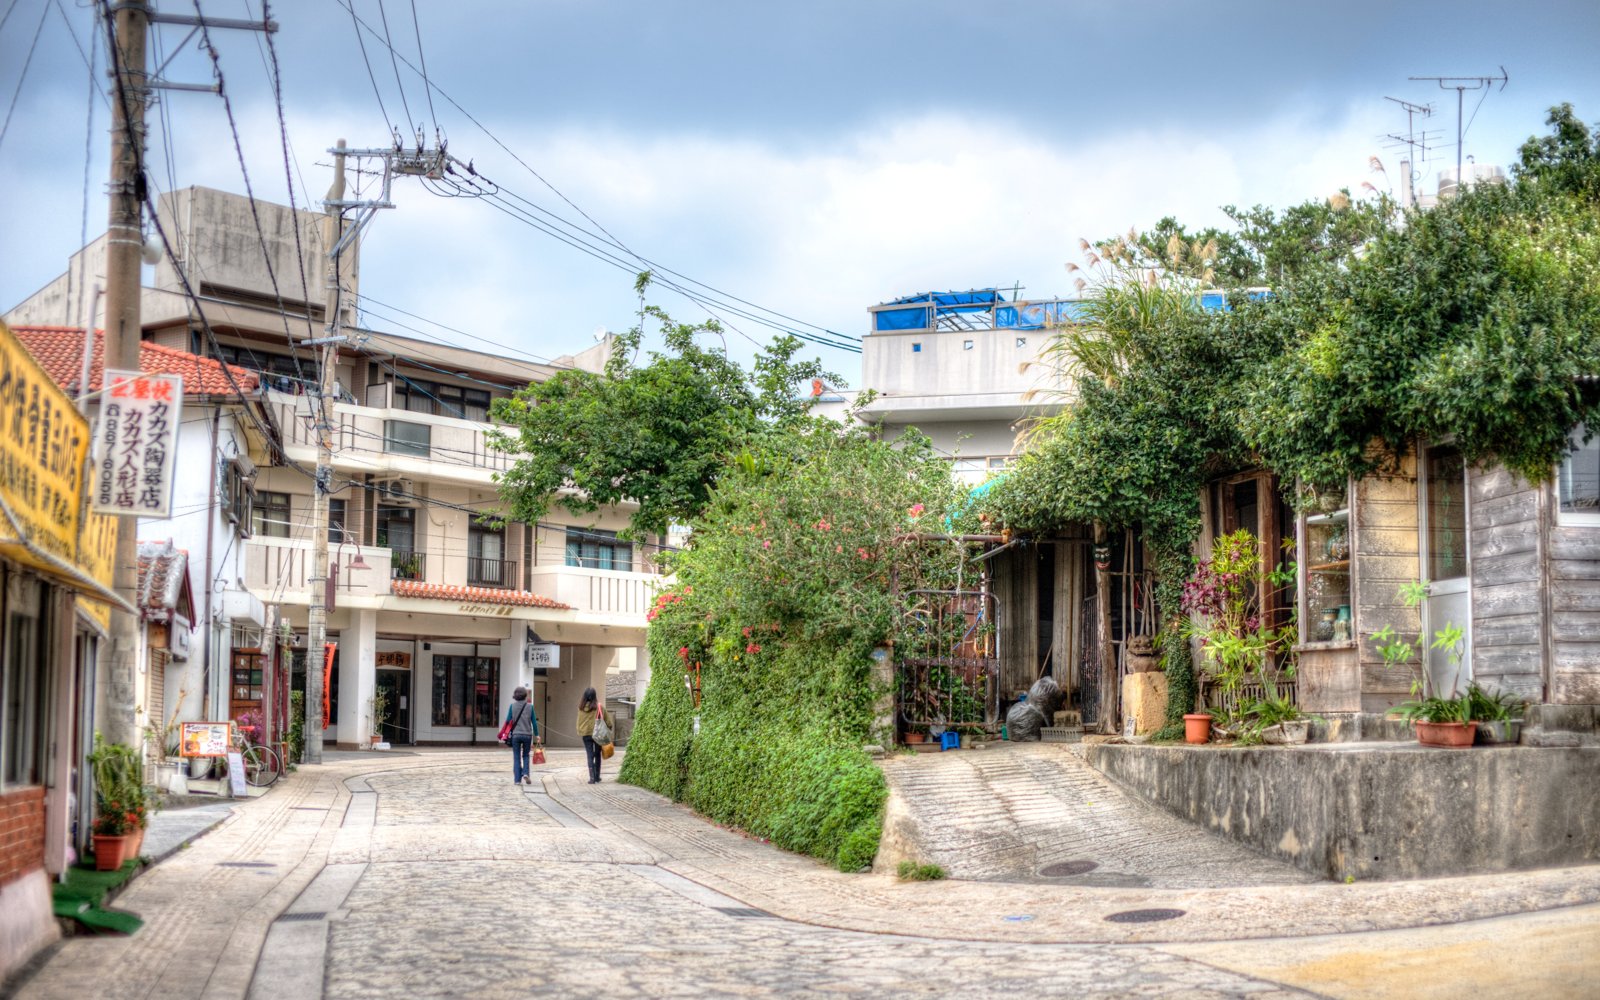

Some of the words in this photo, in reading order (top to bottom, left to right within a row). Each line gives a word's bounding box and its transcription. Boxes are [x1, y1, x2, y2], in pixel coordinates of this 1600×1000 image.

[113, 408, 143, 508] カカズ人形店
[138, 401, 169, 509] カカズ陶器店
